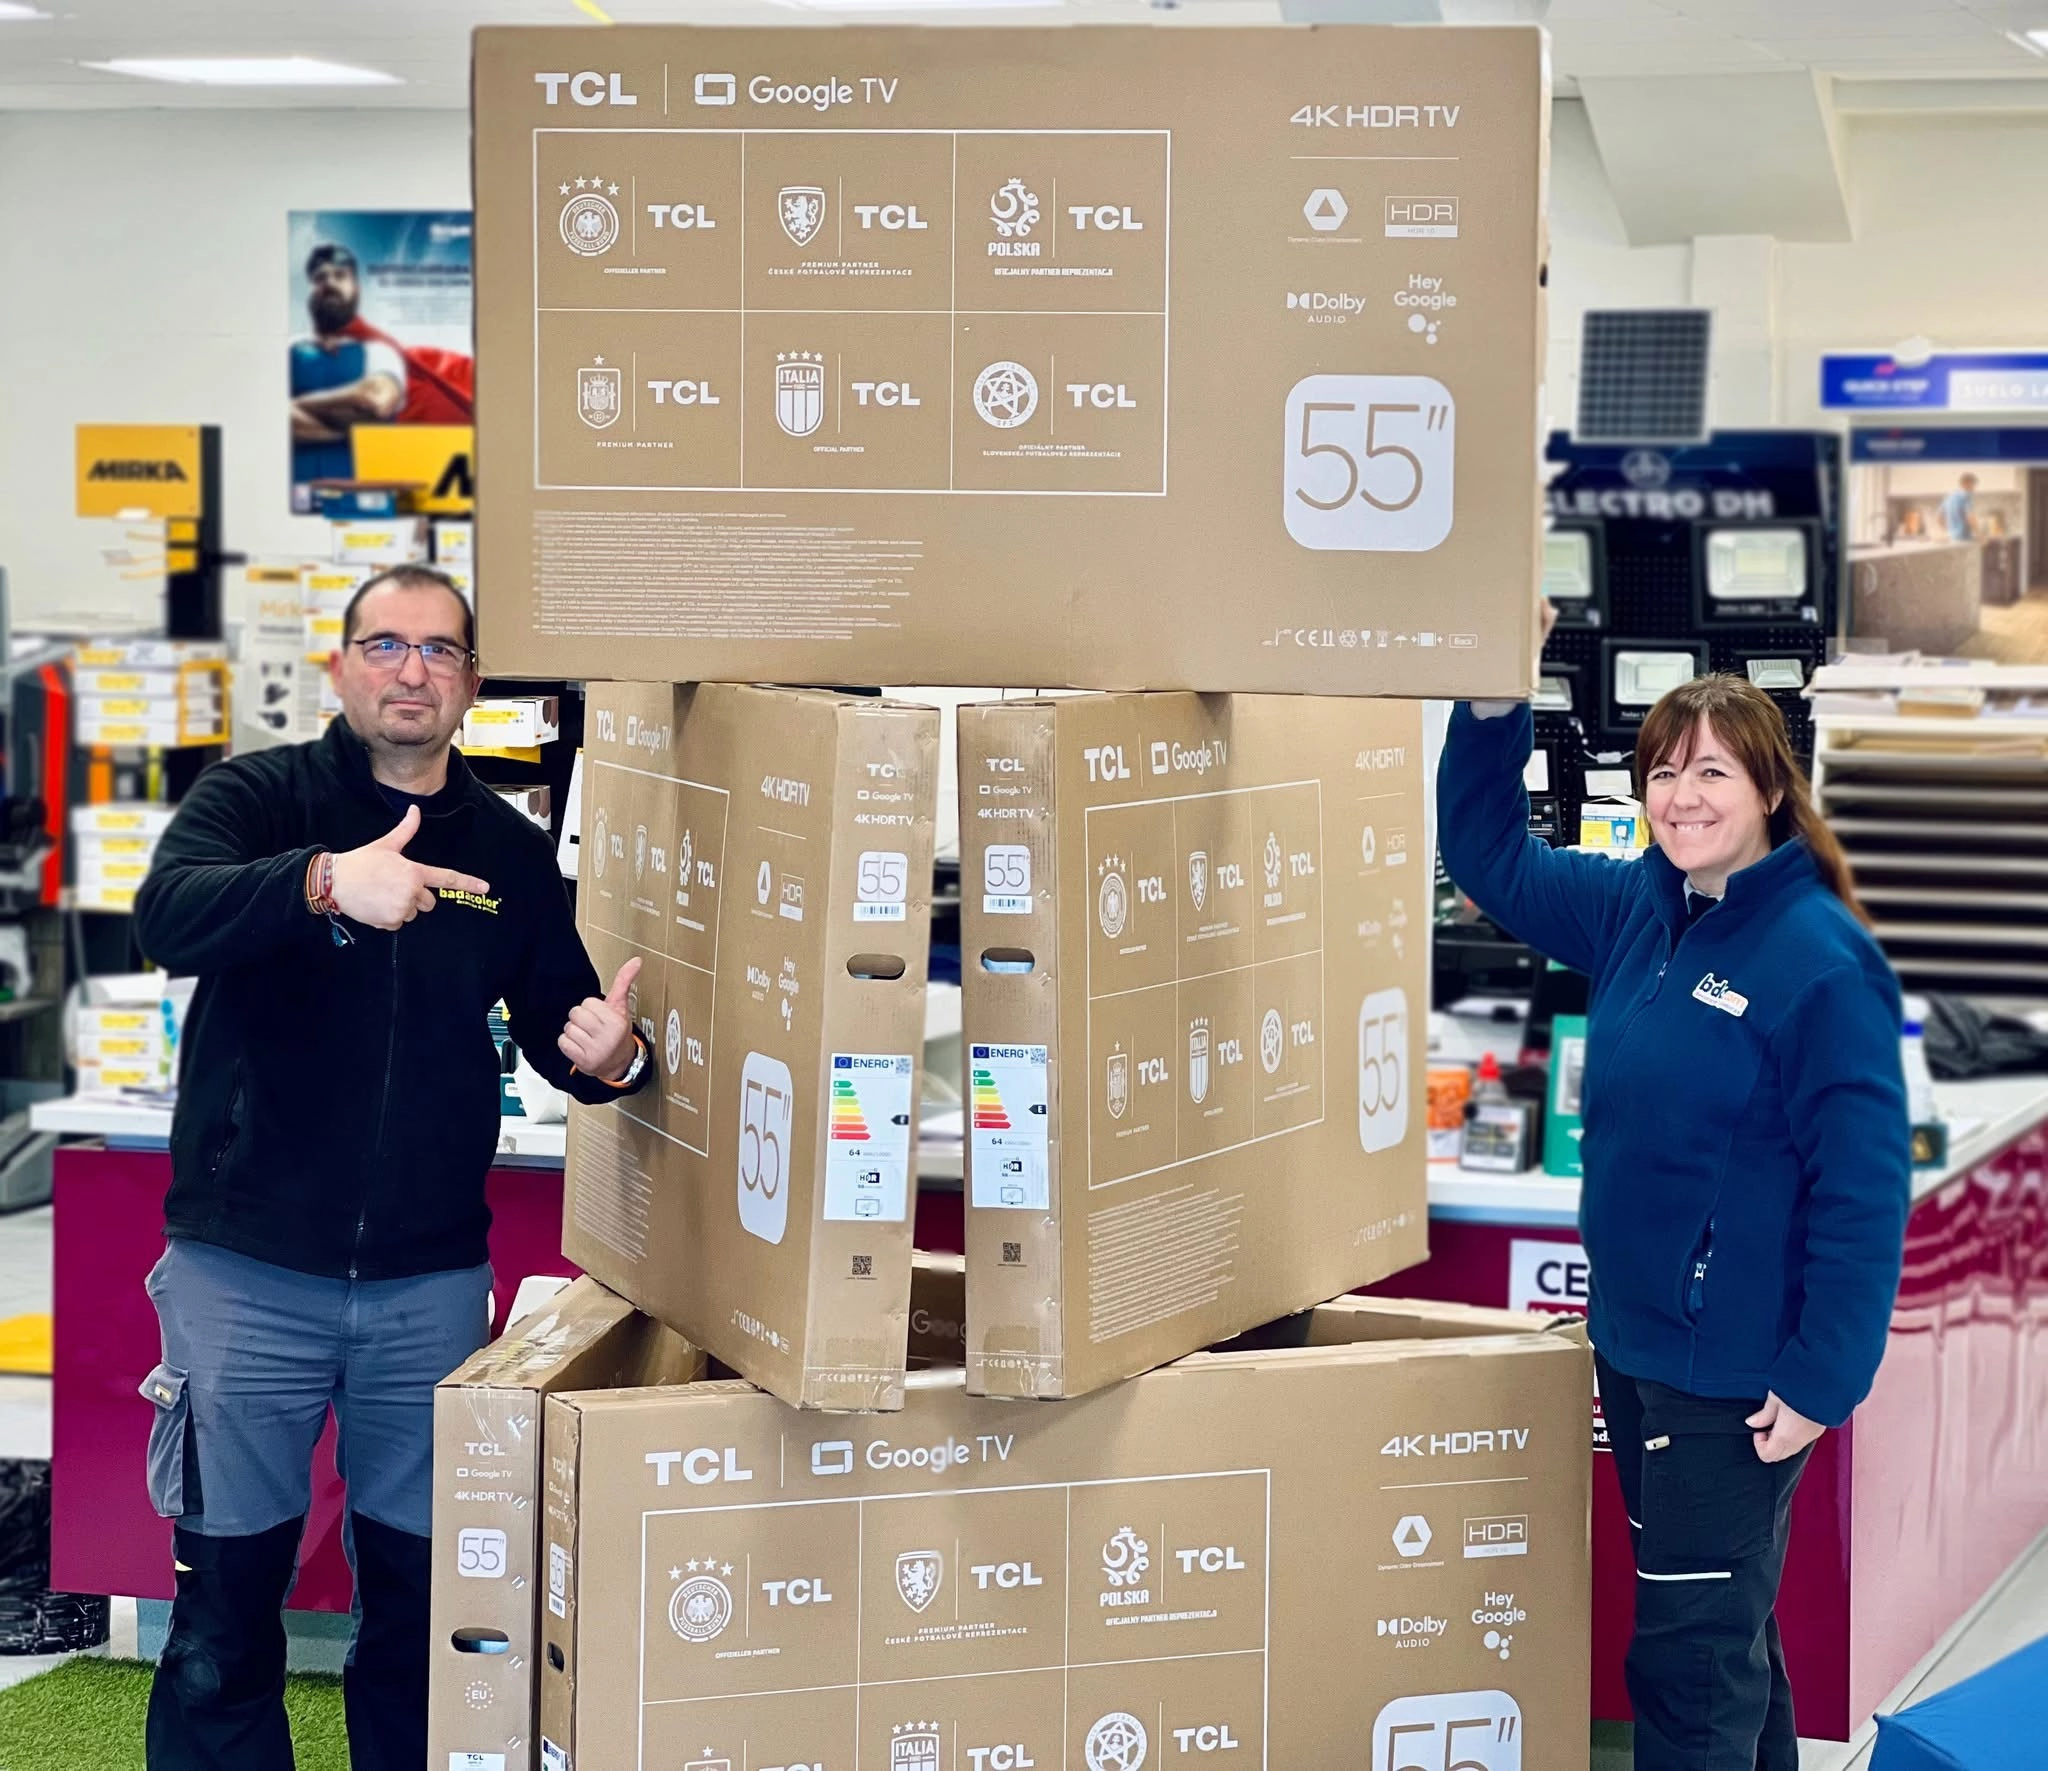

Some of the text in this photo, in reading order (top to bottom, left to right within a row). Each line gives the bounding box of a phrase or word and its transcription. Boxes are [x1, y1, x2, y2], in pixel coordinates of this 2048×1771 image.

[535, 71, 637, 106] TCL
[749, 75, 898, 111] Google TV
[1289, 104, 1461, 128] 4K HDR TV
[647, 203, 716, 229] TCL
[854, 204, 928, 230] TCL
[1068, 205, 1144, 231] TCL
[1391, 204, 1453, 222] HDR
[987, 242, 1041, 257] POLSKA
[1409, 273, 1443, 293] Hey
[1312, 292, 1366, 315] Dolby
[1393, 290, 1457, 311] Google
[1307, 315, 1346, 324] AUDIO
[779, 369, 819, 384] ITALIA
[647, 380, 721, 405] TCL
[851, 381, 921, 407] TCL
[1066, 383, 1137, 408] TCL
[87, 459, 190, 482] MIRKA
[1713, 490, 1776, 518] DH
[596, 709, 616, 743] TCL
[637, 719, 673, 757] Google TV
[985, 758, 1025, 772] TCL
[1084, 744, 1131, 782] TCL
[1171, 739, 1227, 776] Google TV
[760, 775, 776, 800] 4K
[776, 777, 798, 804] HDR
[871, 790, 914, 803] Google TV
[992, 785, 1033, 796] Google TV
[854, 814, 871, 825] 4K
[871, 815, 897, 825] HDR
[977, 808, 993, 818] 4K
[993, 808, 1017, 819] HDR
[610, 833, 624, 859] TCL
[650, 846, 667, 873] TCL
[1289, 851, 1316, 877] TCL
[696, 860, 716, 888] TCL
[1216, 863, 1244, 890] TCL
[782, 881, 803, 903] HDR
[1137, 876, 1167, 904] TCL
[1291, 1020, 1315, 1047] TCL
[686, 1036, 704, 1067] TCL
[853, 1058, 890, 1069] ENERG
[990, 1048, 1024, 1059] ENERG
[1217, 1039, 1243, 1066] TCL
[1137, 1056, 1169, 1086] TCL
[848, 1149, 861, 1157] 64
[991, 1137, 1003, 1145] 64
[464, 1441, 506, 1456] TCL
[865, 1435, 1014, 1473] Google TV
[1380, 1428, 1530, 1457] 4K HDR TV
[470, 1469, 513, 1480] Google TV
[644, 1447, 753, 1486] TCL
[454, 1491, 470, 1501] 4K
[471, 1492, 496, 1501] HDR
[1468, 1522, 1524, 1542] HDR
[1175, 1546, 1245, 1573] TCL
[970, 1561, 1043, 1590] TCL
[761, 1578, 833, 1606] TCL
[1099, 1589, 1150, 1607] POLSKA
[1484, 1591, 1515, 1609] Hey
[918, 1622, 995, 1634] PREMIUM PARTNER
[1400, 1615, 1448, 1636] Dolby
[1471, 1607, 1527, 1626] Google
[1395, 1638, 1430, 1649] AUDIO
[471, 1689, 488, 1700] EU
[895, 1739, 936, 1757] ITALIA
[1172, 1725, 1239, 1753] TCL
[966, 1743, 1035, 1771] TCL
